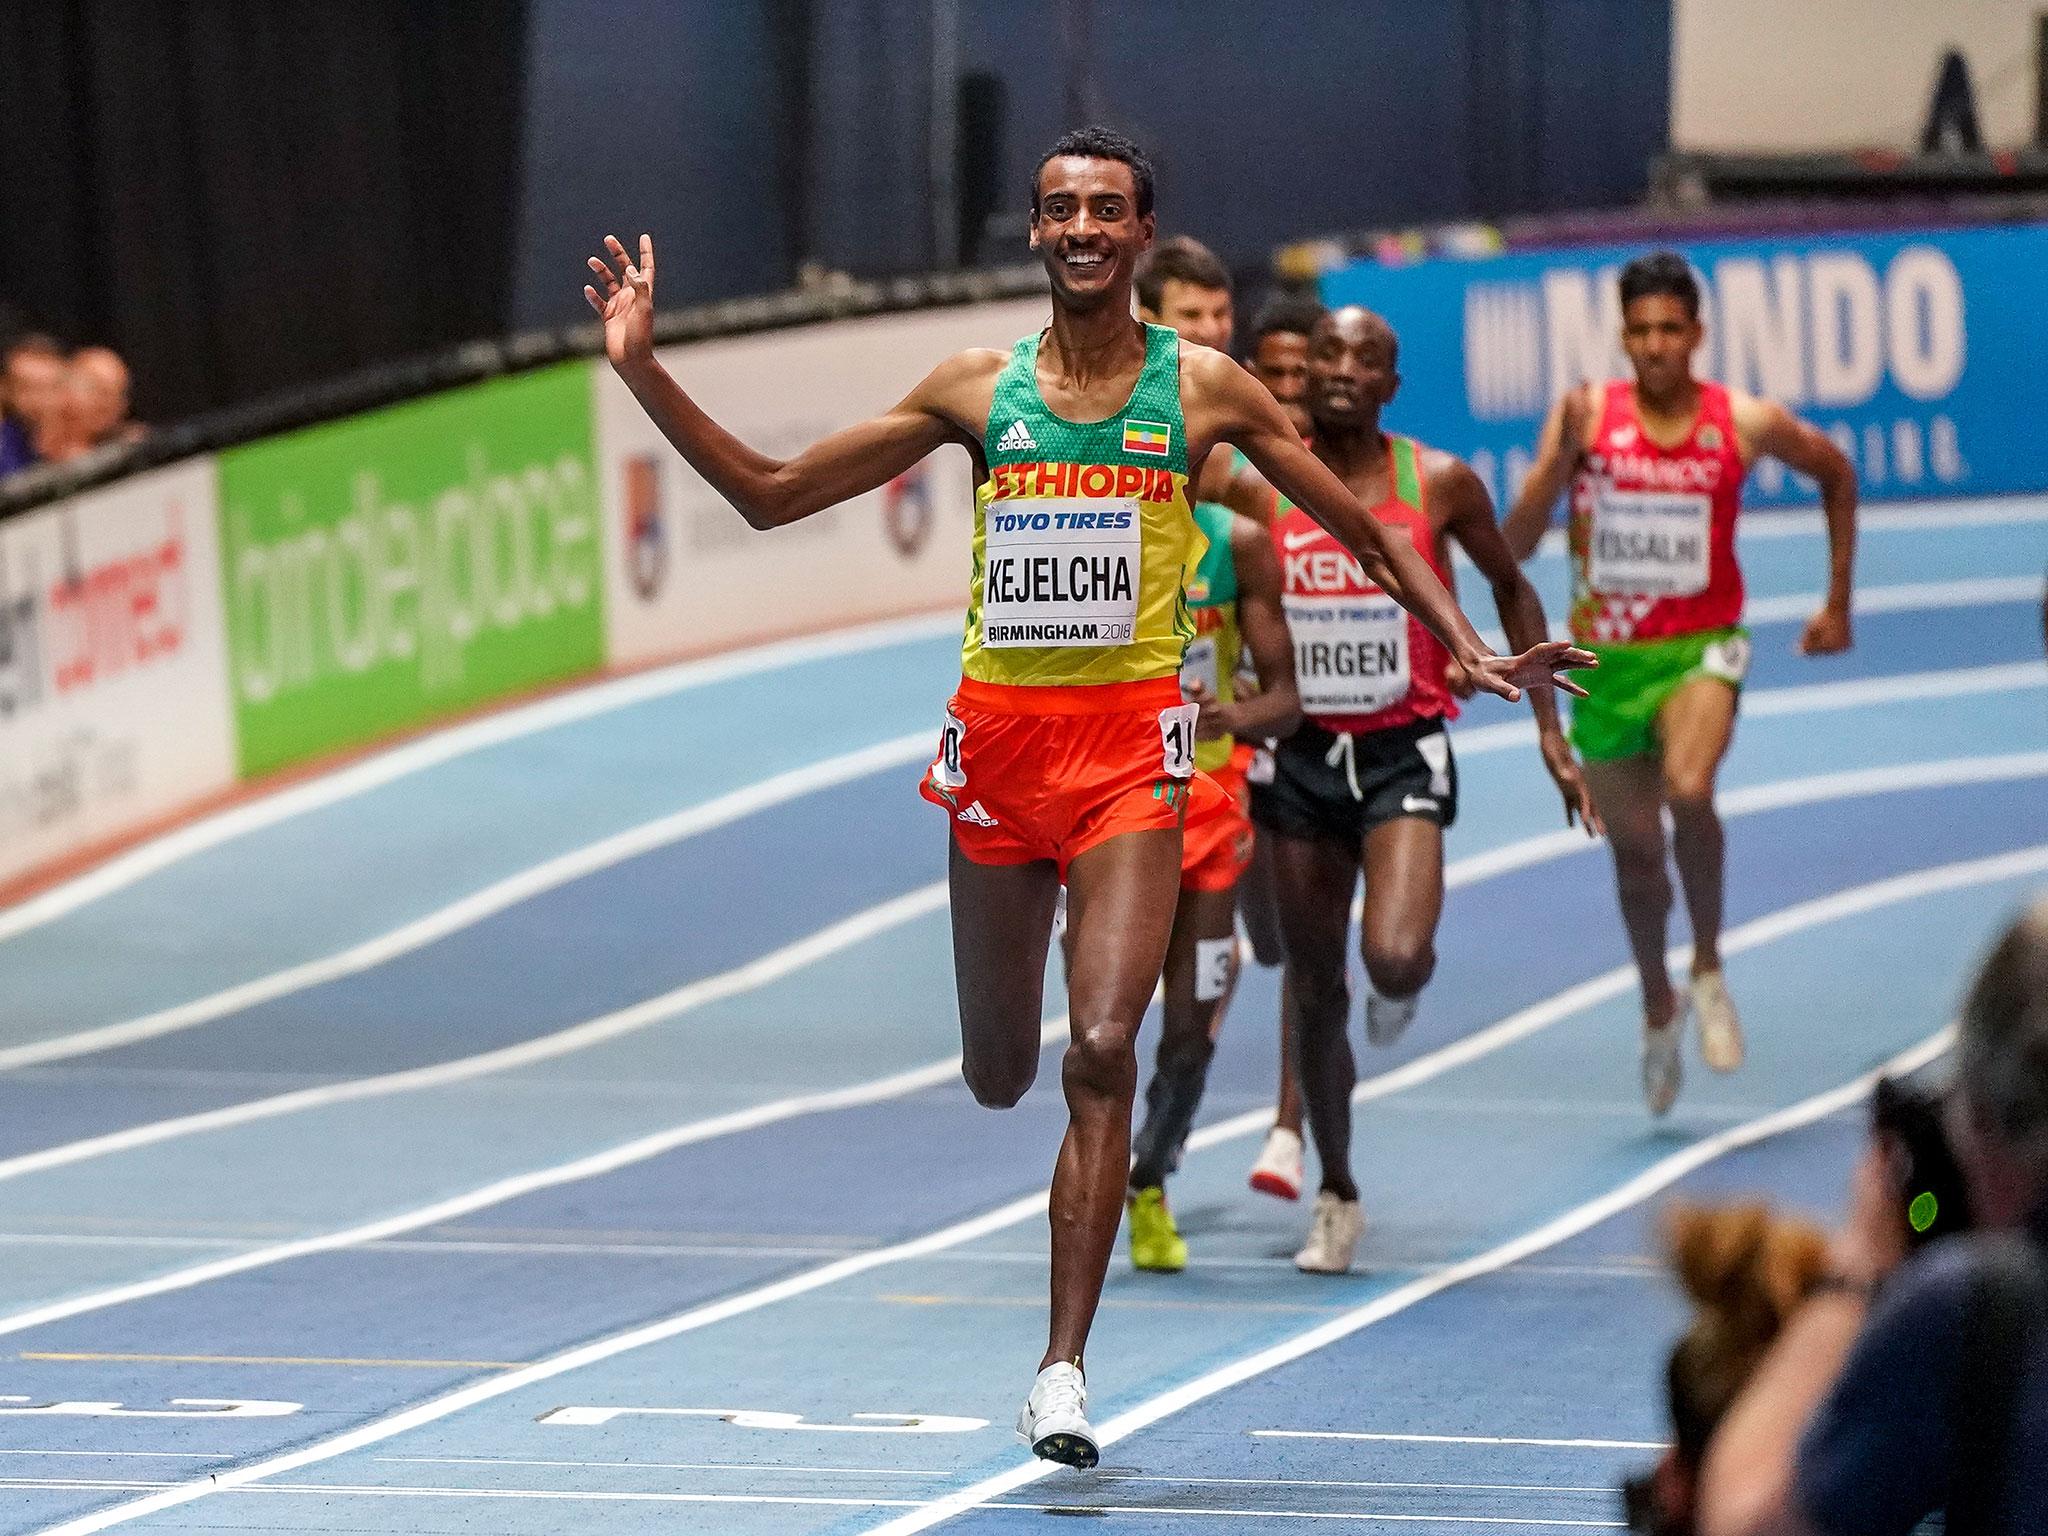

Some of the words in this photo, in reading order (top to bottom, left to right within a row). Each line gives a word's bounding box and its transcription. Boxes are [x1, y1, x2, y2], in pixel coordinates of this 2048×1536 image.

[1543, 245, 1967, 409] MNDO
[996, 438, 1037, 451] adidas
[992, 462, 1174, 503] ETHIOPIA
[995, 513, 1051, 533] TOYO
[1054, 511, 1132, 530] TIRES
[987, 556, 1132, 603] KEJELCHA
[988, 624, 1099, 641] BIRMINGHAM
[1100, 623, 1131, 639] 2018
